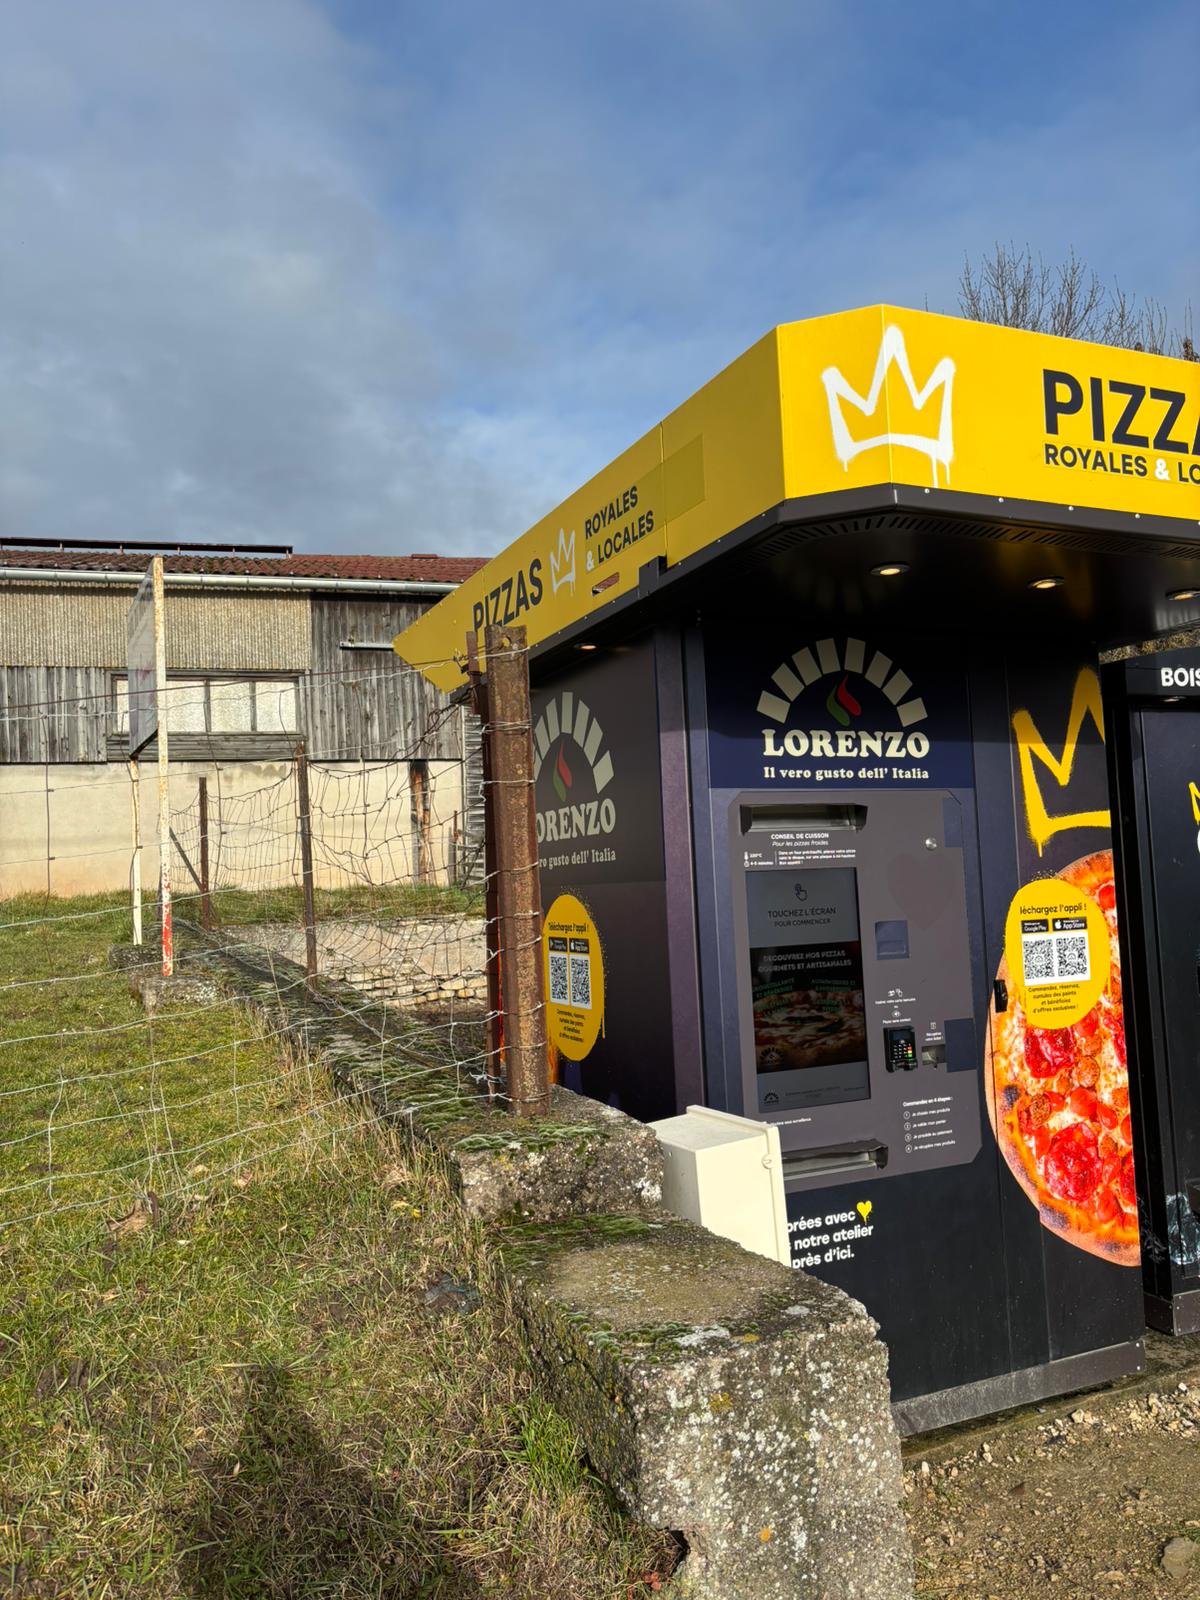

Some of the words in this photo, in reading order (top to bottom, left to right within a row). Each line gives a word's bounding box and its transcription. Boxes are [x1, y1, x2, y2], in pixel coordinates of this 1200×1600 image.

[1043, 368, 1200, 456] PIZZ
[1045, 443, 1148, 477] ROYALES
[1154, 458, 1170, 481] &
[1178, 462, 1200, 485] LO
[585, 485, 638, 540] ROYALES
[586, 550, 595, 571] &
[597, 510, 654, 564] LOCALES
[473, 558, 543, 632] PIZZAS
[762, 729, 930, 758] LORENZO
[764, 766, 776, 778] Il
[780, 768, 811, 778] vero
[815, 768, 854, 781] gusto
[892, 768, 929, 779] Italia
[536, 798, 616, 843] ORENZO
[549, 855, 569, 870] gusto
[592, 848, 616, 863] Italia
[768, 909, 804, 919] TOUCHEZ
[774, 919, 792, 927] POUR
[792, 918, 831, 927] COMMENCER
[787, 1216, 822, 1233] orées
[825, 1211, 856, 1225] avec
[794, 1234, 830, 1250] notre
[833, 1224, 874, 1242] atelier
